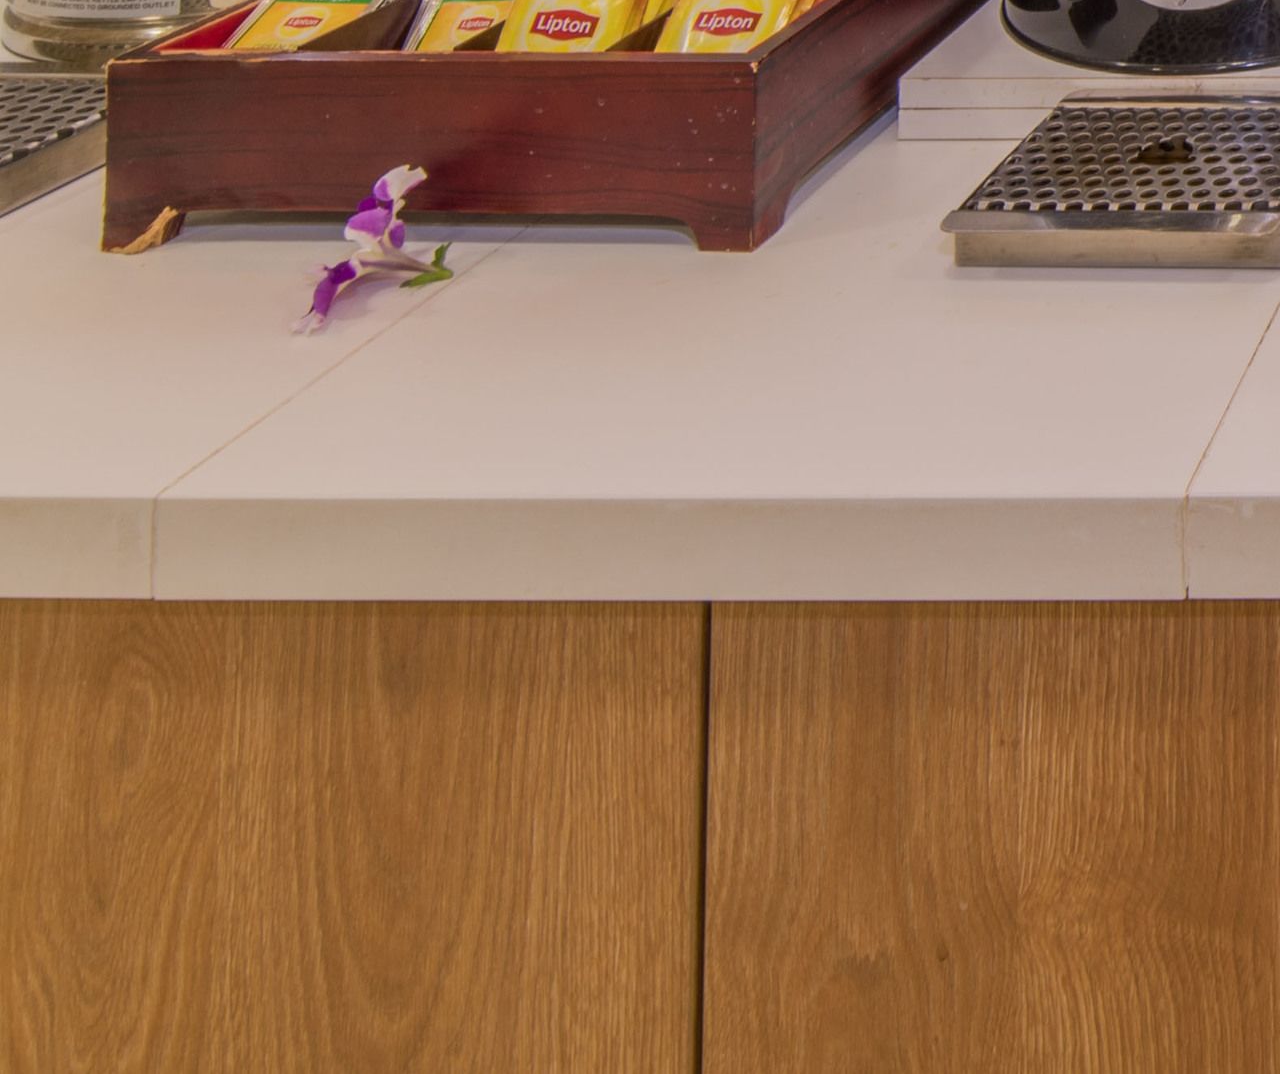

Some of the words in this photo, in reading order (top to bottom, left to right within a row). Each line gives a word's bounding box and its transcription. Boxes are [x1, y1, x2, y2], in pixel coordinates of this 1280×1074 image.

[142, 1, 175, 9] OUTLET
[536, 14, 592, 34] Lipton
[698, 11, 754, 30] Lipton
